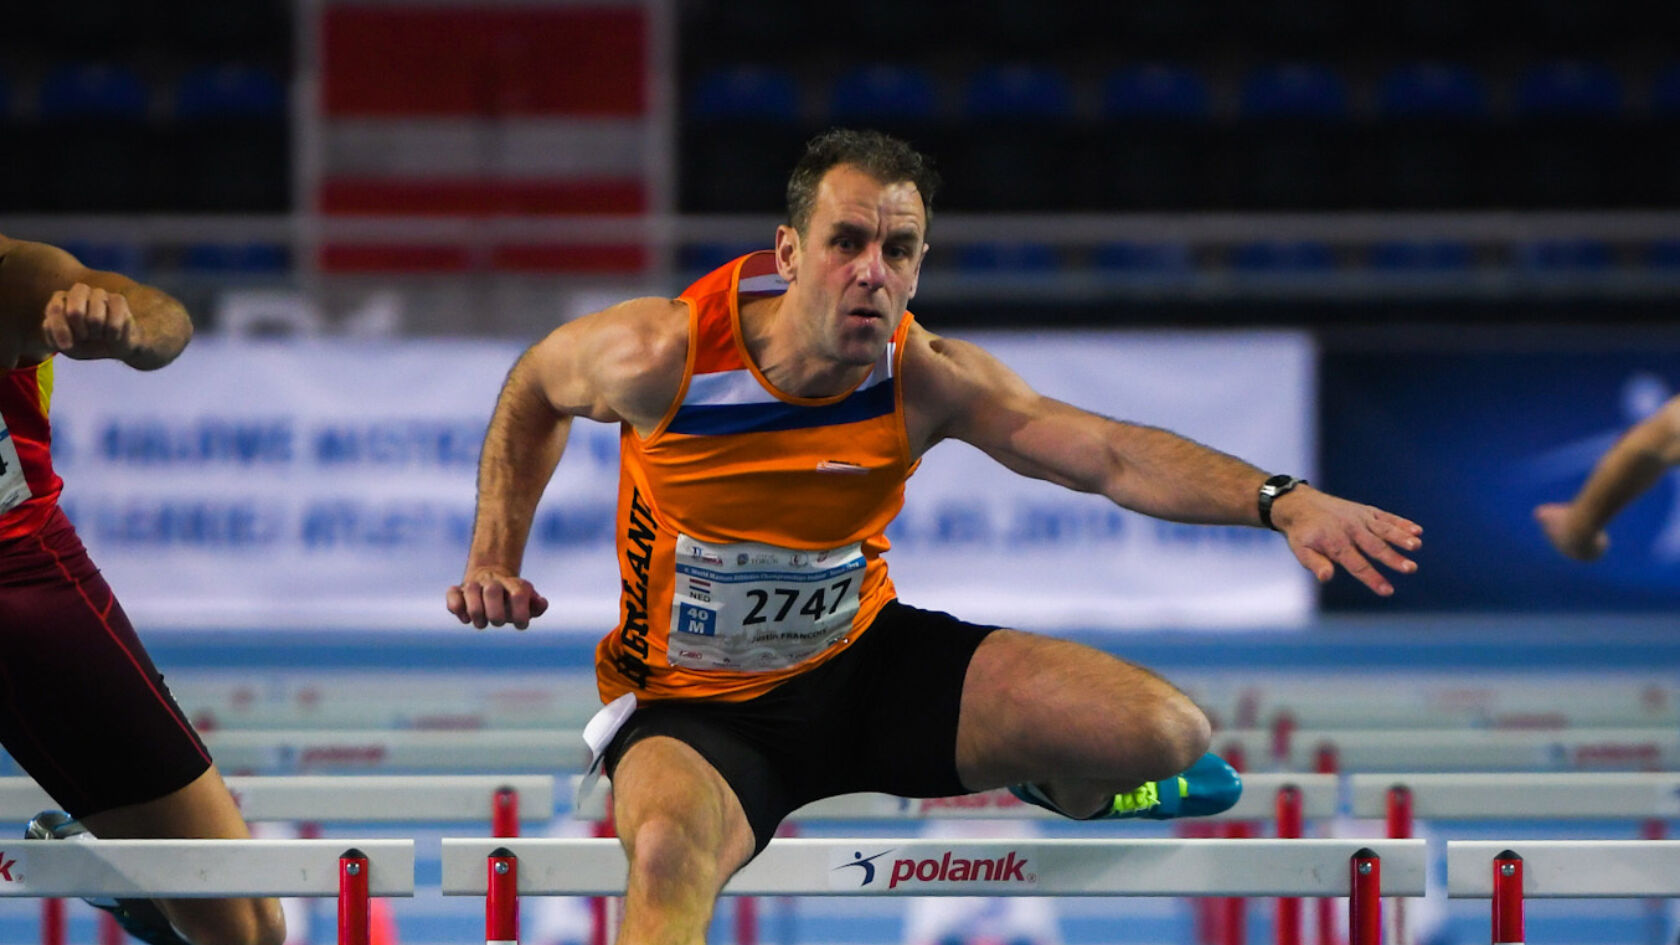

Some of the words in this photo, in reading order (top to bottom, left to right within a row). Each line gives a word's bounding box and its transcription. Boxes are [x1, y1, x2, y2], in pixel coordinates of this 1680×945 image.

[689, 591, 712, 603] NED
[742, 578, 852, 626] 2747
[687, 607, 709, 621] 40
[688, 620, 704, 634] M
[889, 851, 1029, 889] polanik
